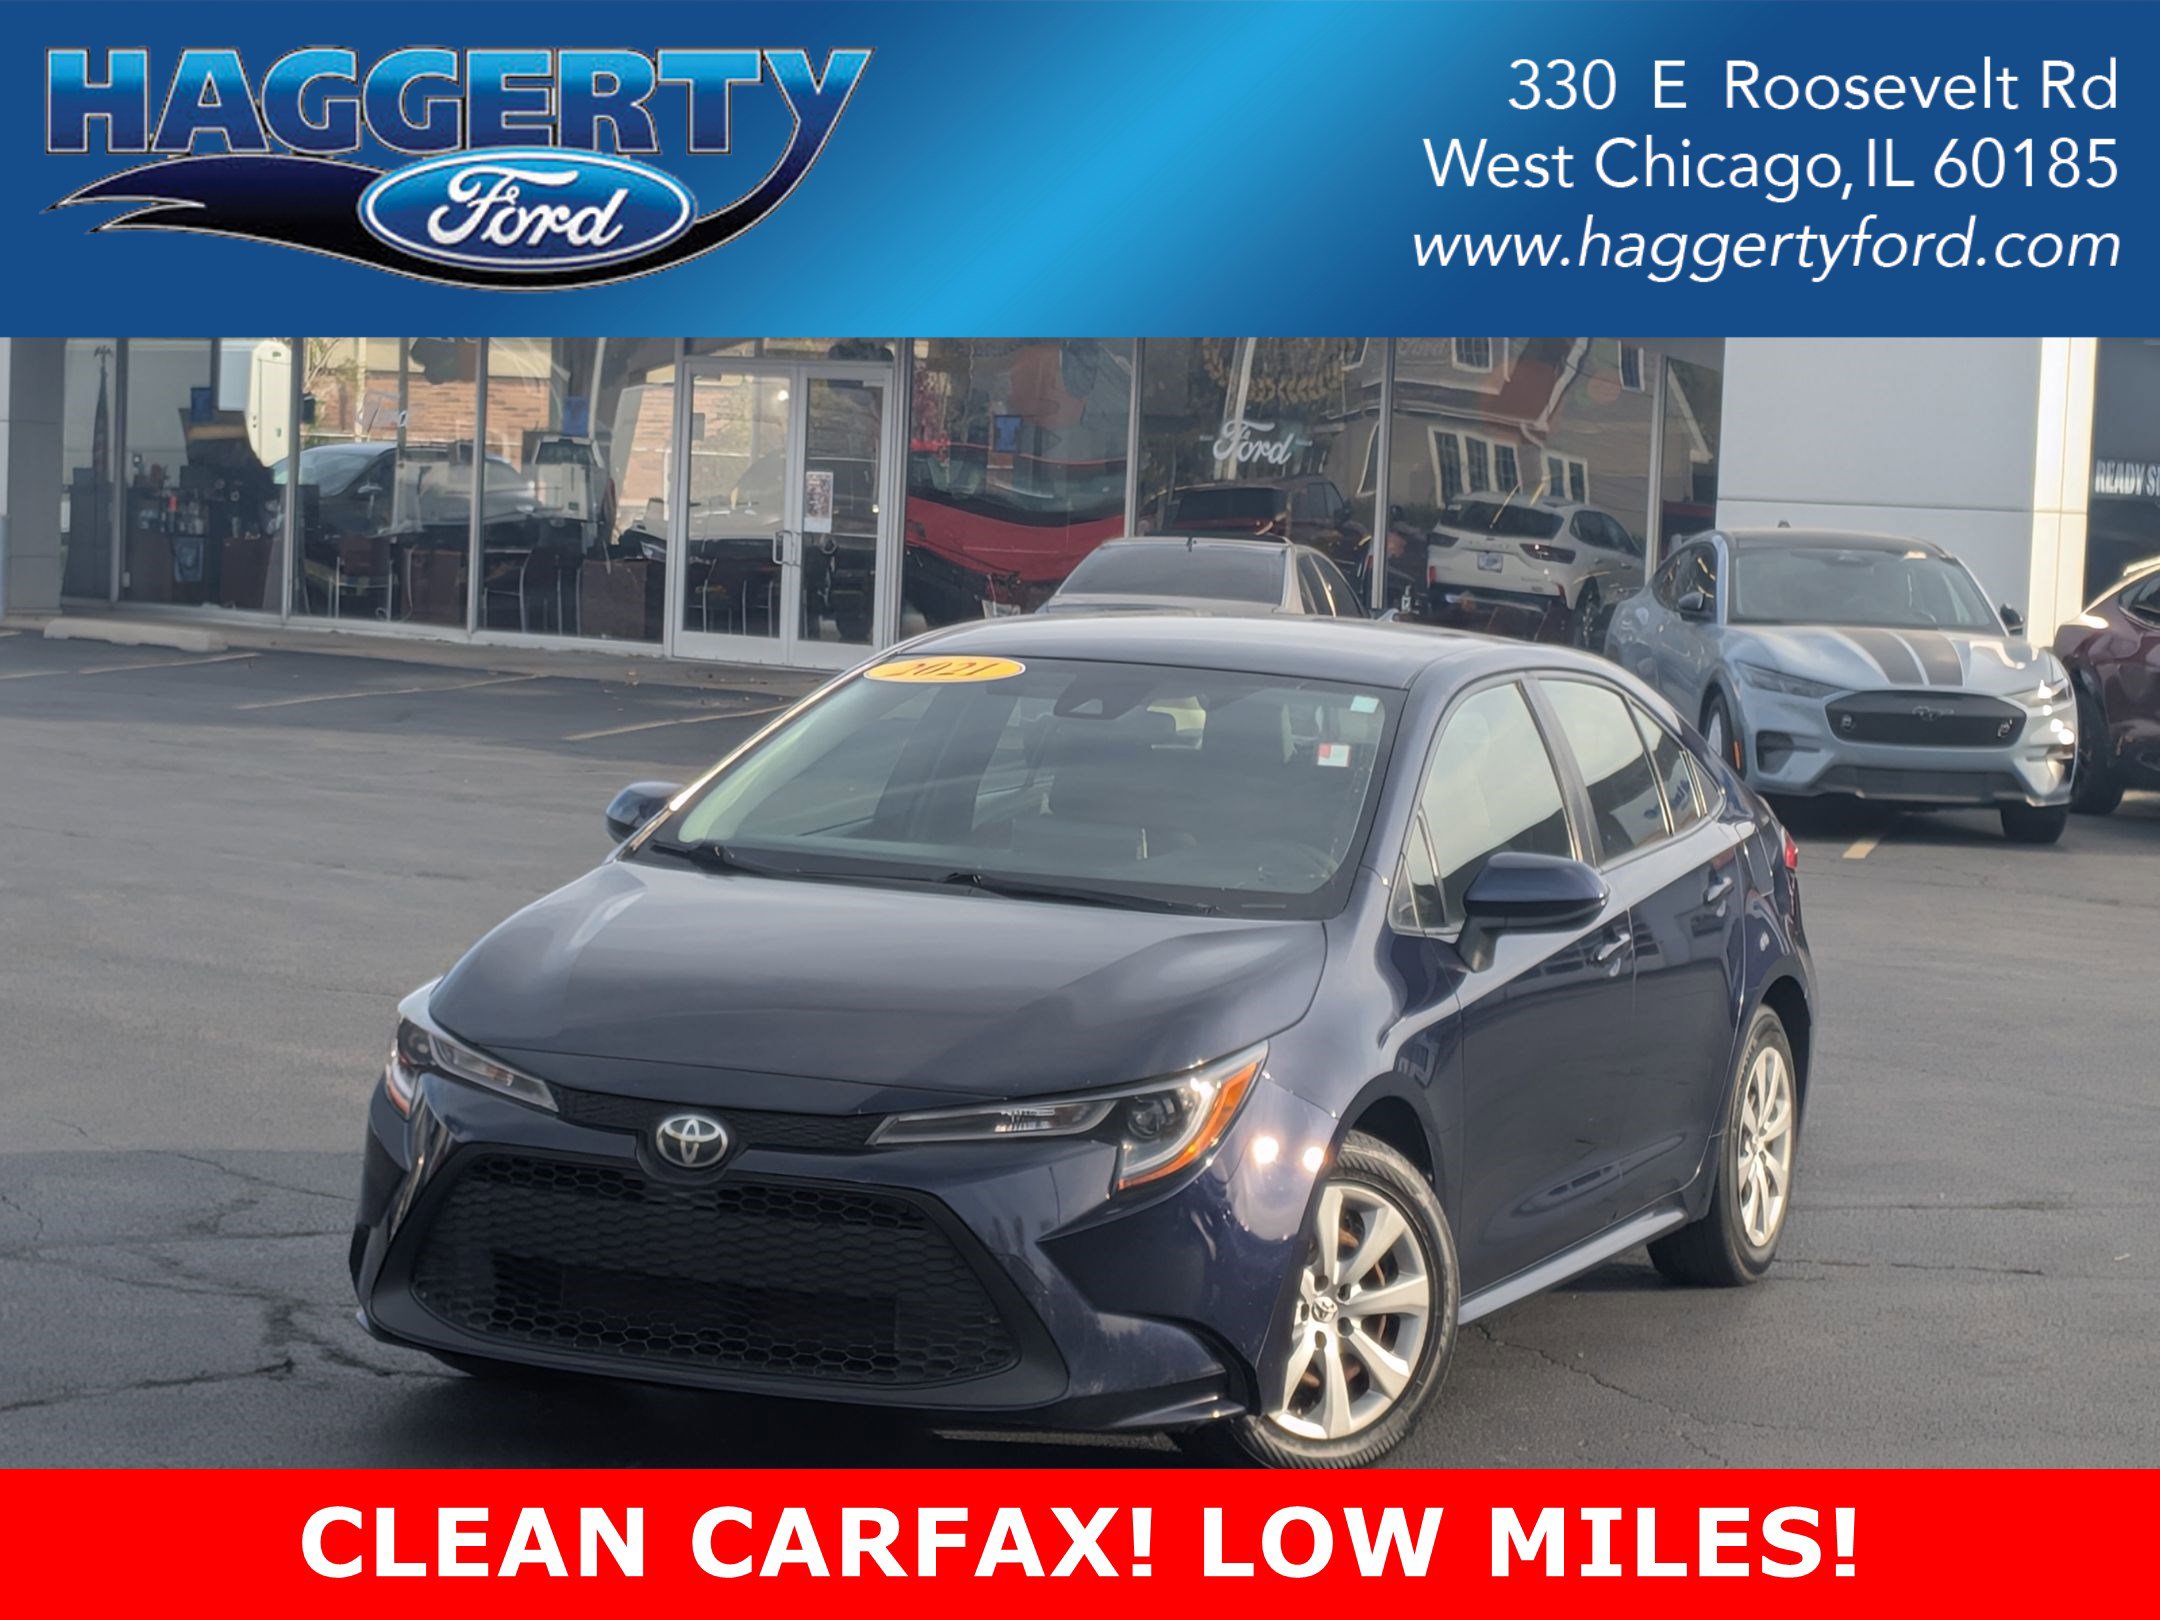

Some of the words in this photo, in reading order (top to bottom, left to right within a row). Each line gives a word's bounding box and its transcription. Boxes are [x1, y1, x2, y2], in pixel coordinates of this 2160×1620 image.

[1212, 420, 1295, 464] Ford
[2095, 460, 2145, 496] READY
[2146, 464, 2160, 497] S
